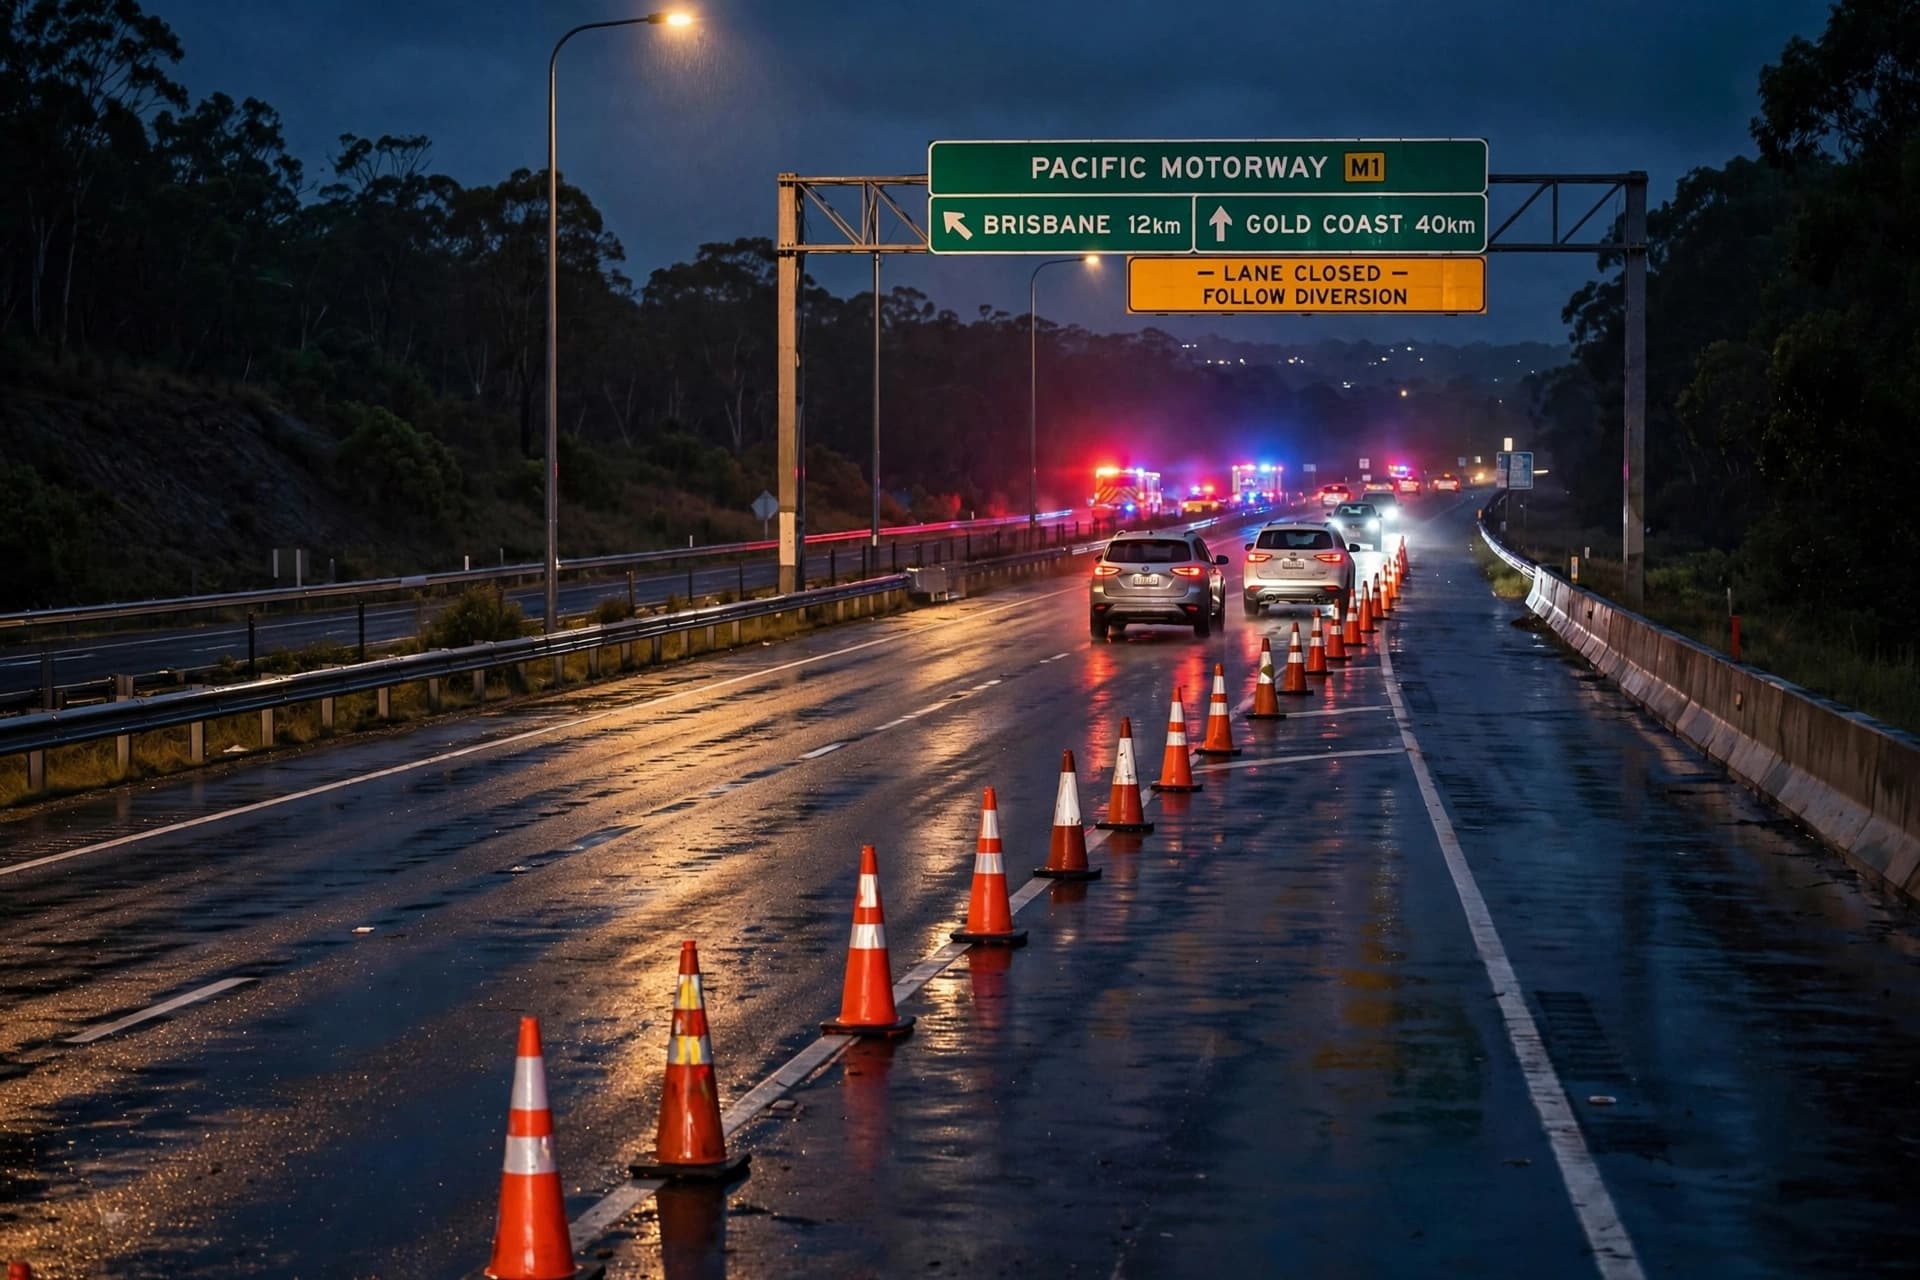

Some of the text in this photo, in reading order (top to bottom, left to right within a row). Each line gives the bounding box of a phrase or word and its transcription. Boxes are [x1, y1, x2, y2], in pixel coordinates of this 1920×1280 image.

[1032, 156, 1380, 179] PACIFIC MOTORWAY M1
[984, 214, 1181, 235] BRISBANE 12km
[1246, 214, 1475, 234] GOLD COAST 40km
[1224, 264, 1381, 283] LANE CLOSED
[1203, 287, 1407, 305] FOLLOW DIVERSION
